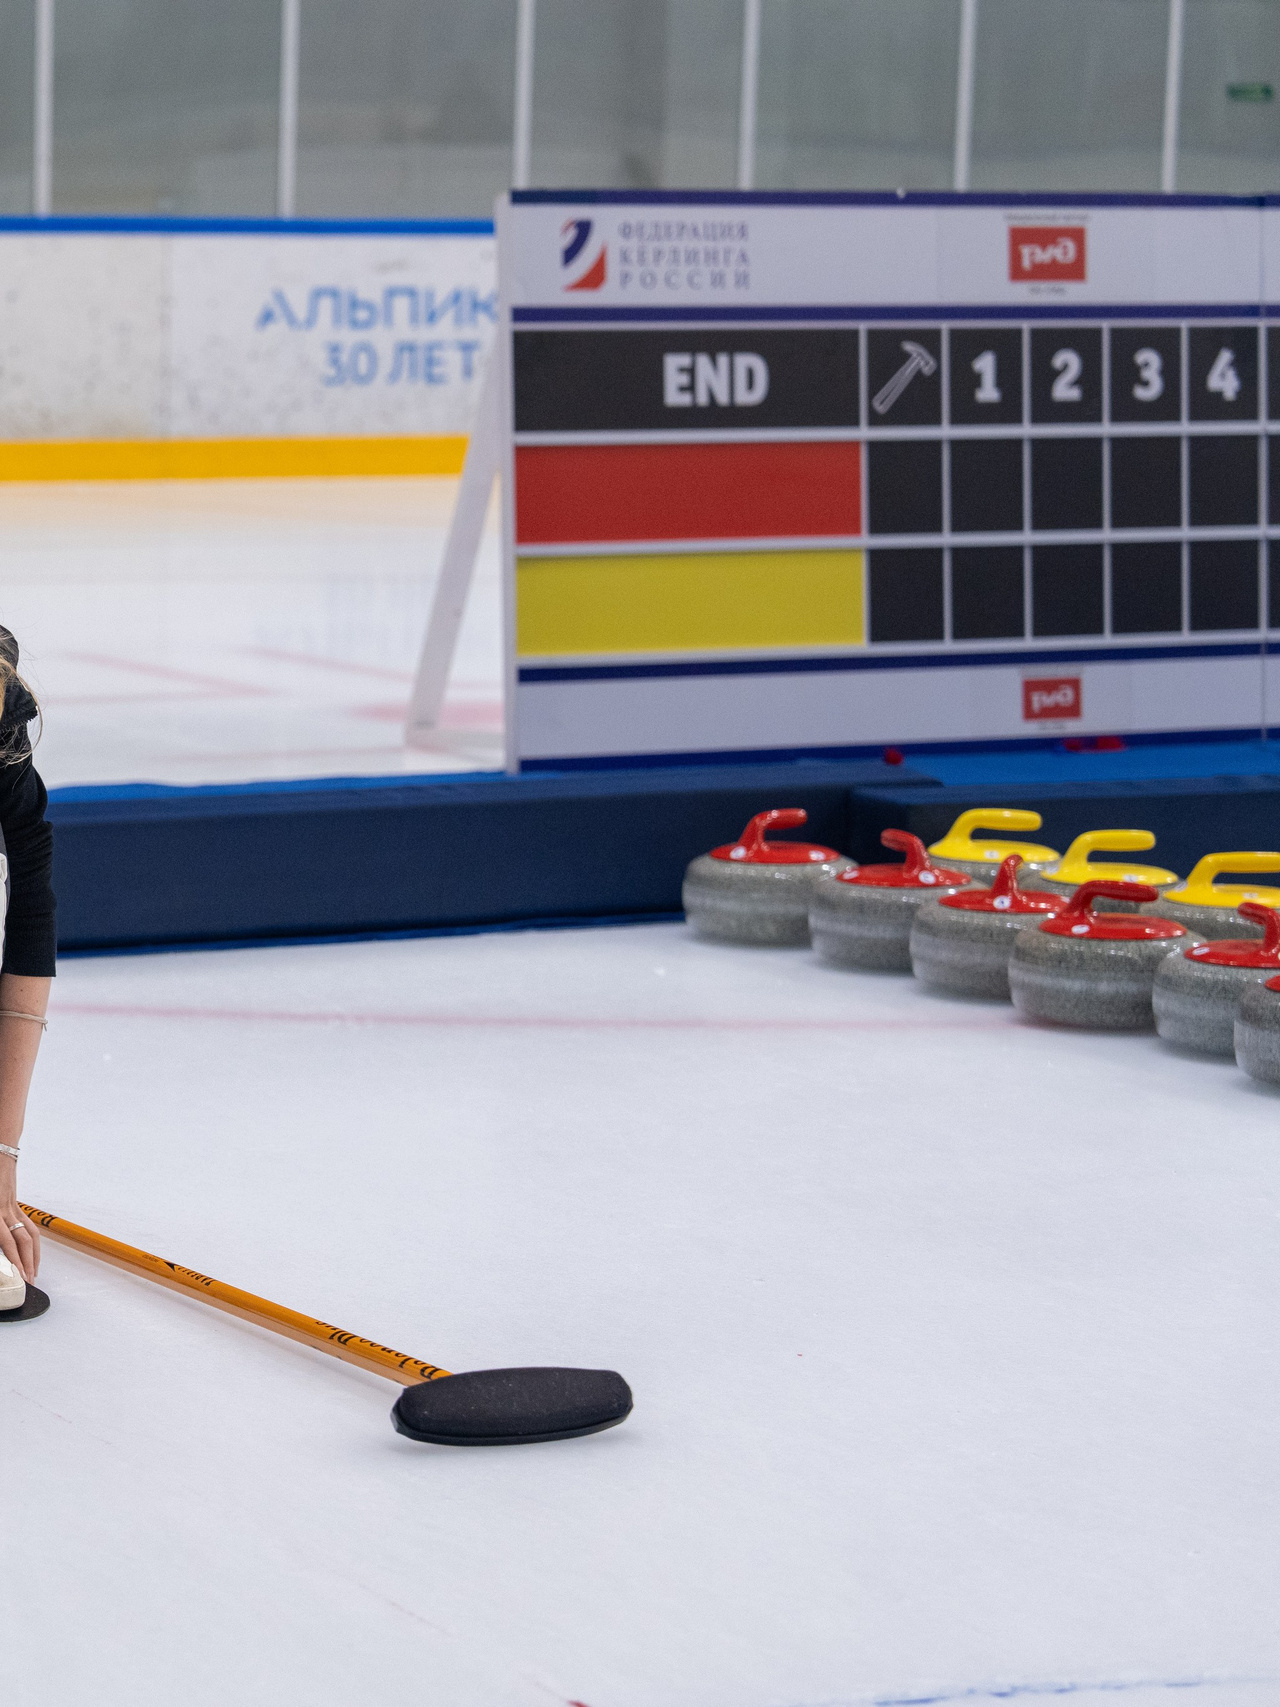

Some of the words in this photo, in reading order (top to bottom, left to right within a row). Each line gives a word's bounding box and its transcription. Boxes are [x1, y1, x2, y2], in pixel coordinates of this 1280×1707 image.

[618, 221, 750, 241] ФЕДЕРАЦИЯ
[619, 269, 751, 291] РОССИИ
[323, 340, 378, 388] 30
[386, 339, 481, 387] ЛЕТ
[663, 352, 770, 407] END
[971, 350, 1001, 402] 1
[1051, 348, 1082, 401] 2
[1133, 348, 1164, 401] 3
[1206, 348, 1241, 401] 4
